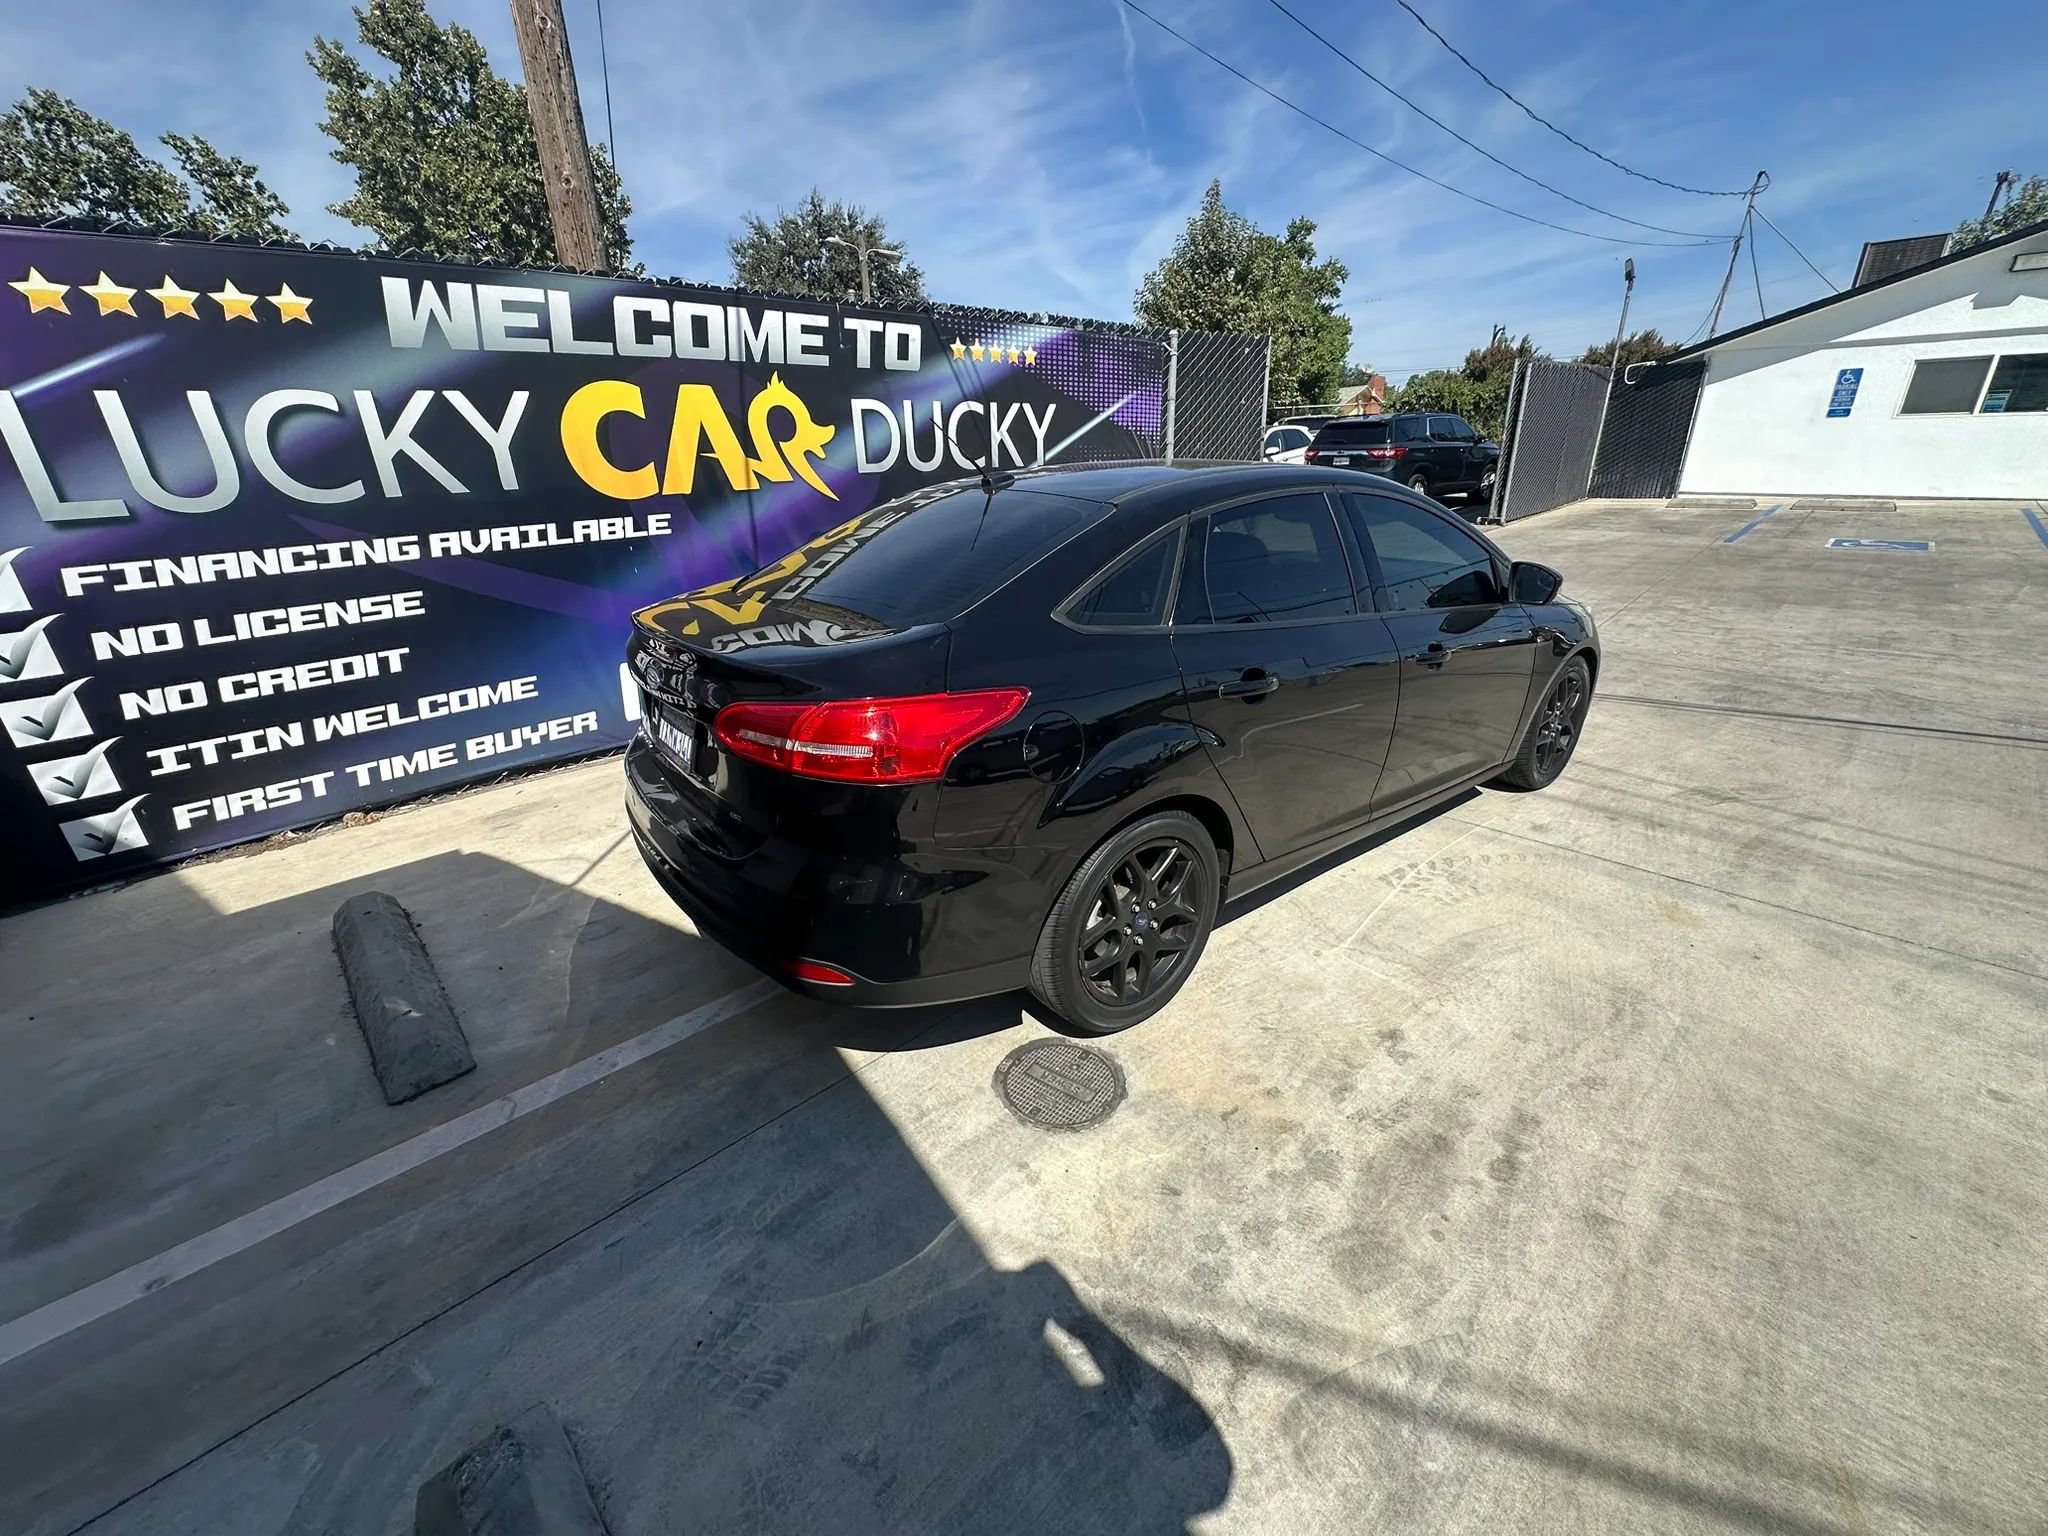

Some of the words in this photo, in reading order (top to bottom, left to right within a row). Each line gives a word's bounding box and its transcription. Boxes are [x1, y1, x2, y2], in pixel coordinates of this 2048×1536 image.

[380, 276, 830, 366] WELCOME
[843, 317, 922, 371] TO
[0, 388, 530, 522] LUCKY
[560, 371, 840, 501] CAR
[850, 398, 1057, 474] DUCKY
[61, 535, 421, 598] FINANCING
[428, 513, 672, 558] AVAILABLE
[92, 622, 184, 661] NO
[195, 590, 426, 648] LICENSE
[118, 680, 209, 721] NO
[217, 647, 410, 707] CREDIT
[146, 720, 304, 778] ITIN
[314, 675, 540, 741] WELCOME
[172, 770, 335, 831] FIRST
[345, 741, 458, 788] TIME
[466, 710, 598, 755] BUYER
[1041, 1070, 1082, 1094] SEWER
